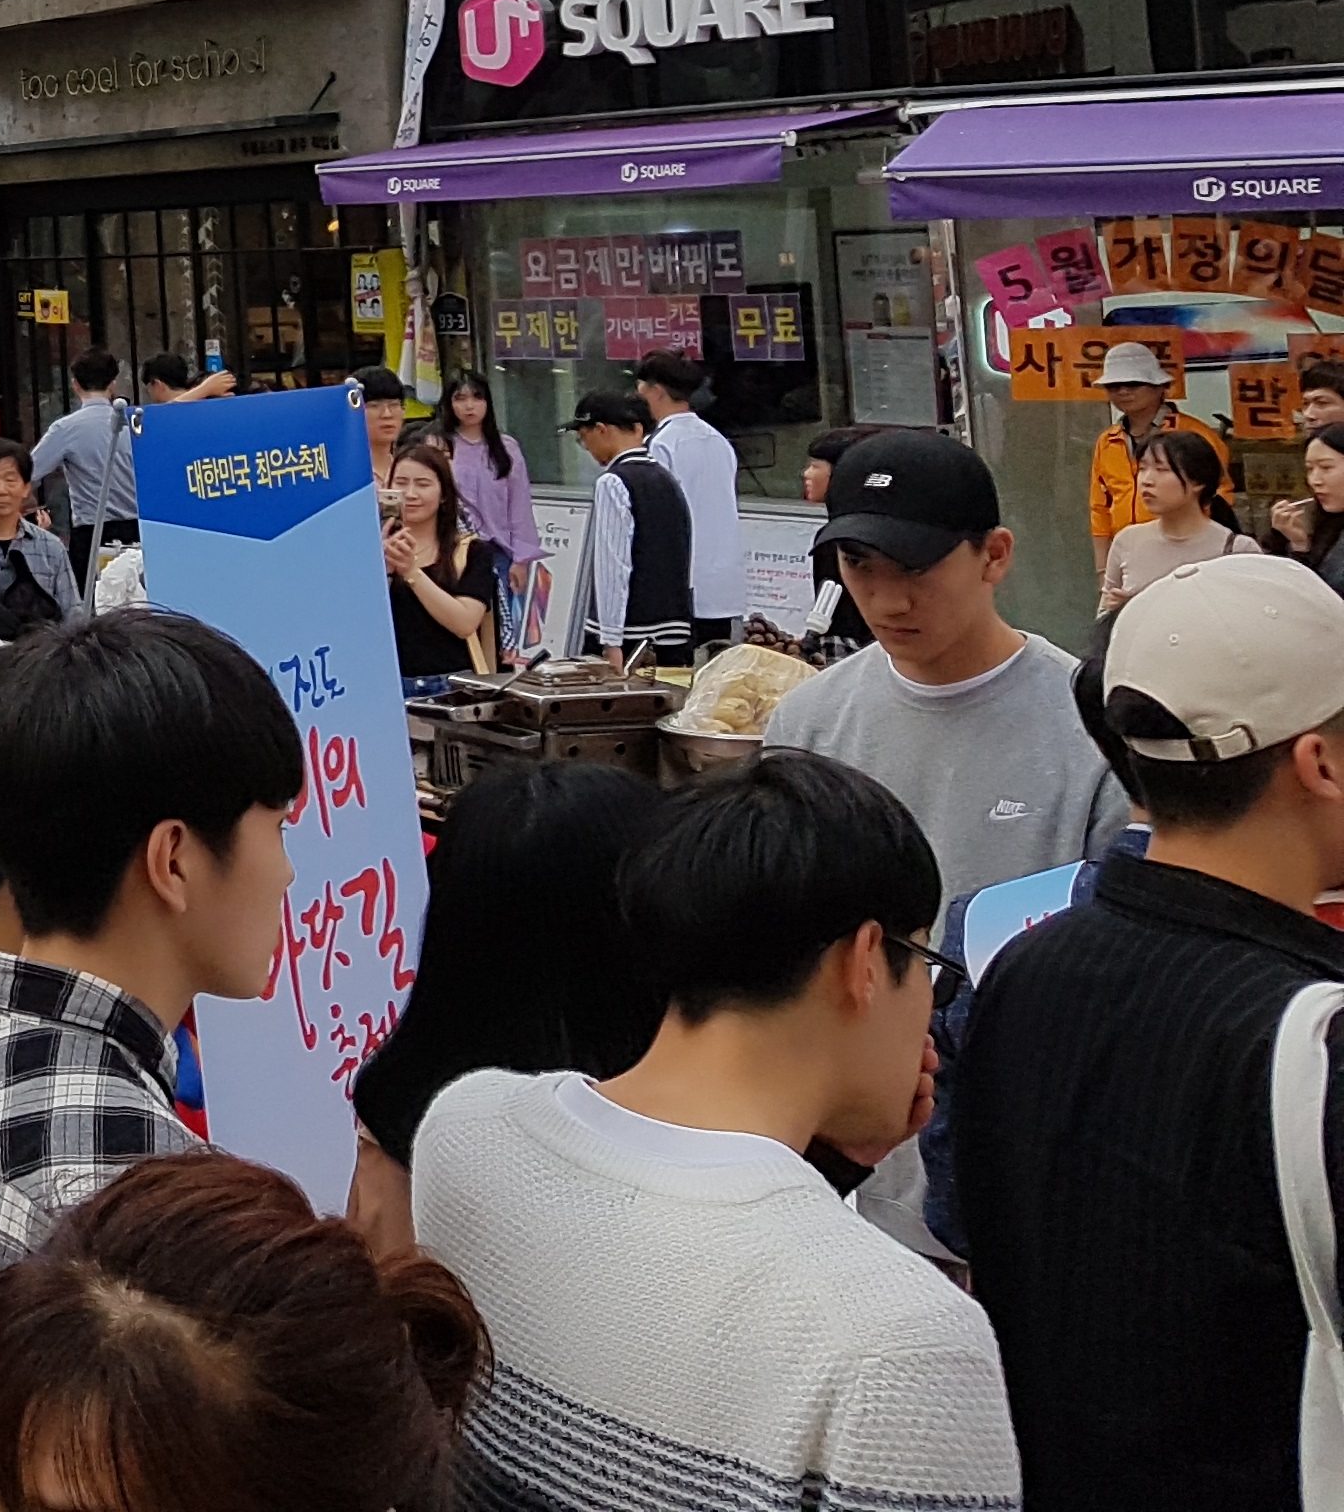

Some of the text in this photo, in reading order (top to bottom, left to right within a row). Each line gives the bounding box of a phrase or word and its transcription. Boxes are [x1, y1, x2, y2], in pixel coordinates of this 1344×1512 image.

[20, 36, 267, 101] too cool for school
[403, 177, 441, 192] SQUARE
[640, 163, 686, 178] SQUARE
[1231, 178, 1322, 199] SQUARE
[997, 244, 1103, 303] 5월
[1113, 232, 1288, 289] 가정의
[495, 310, 580, 351] 무제한
[736, 307, 801, 349] 무료
[670, 303, 701, 331] 키즈
[186, 442, 330, 500] 대한민국 최우수축제
